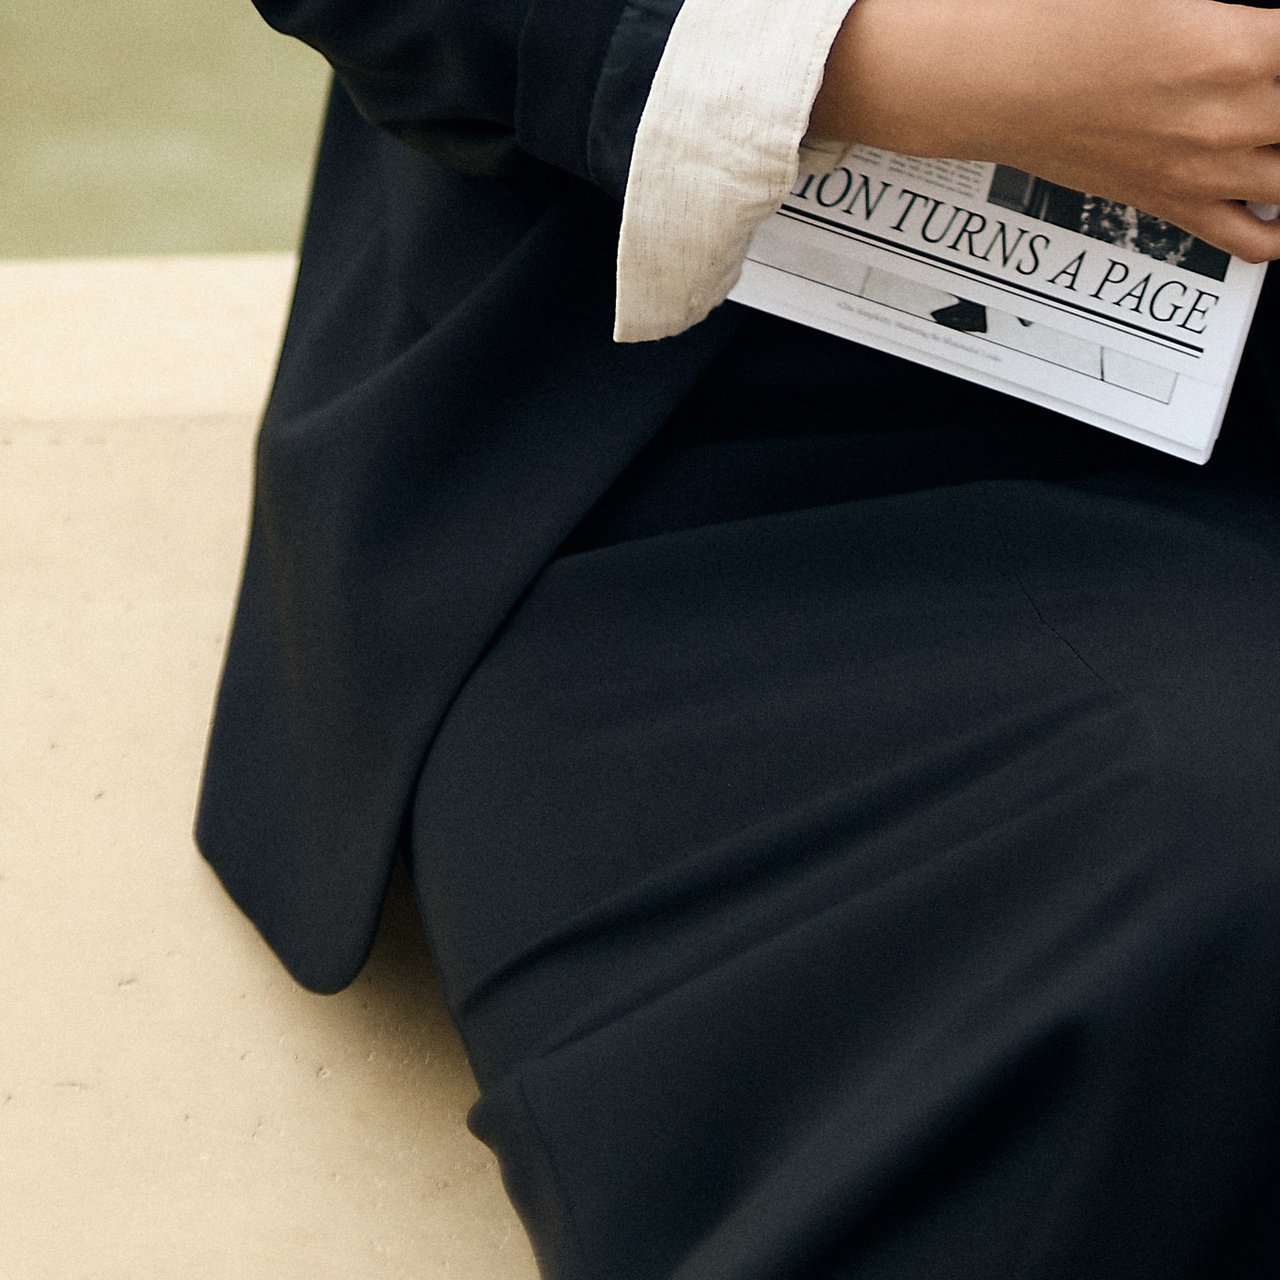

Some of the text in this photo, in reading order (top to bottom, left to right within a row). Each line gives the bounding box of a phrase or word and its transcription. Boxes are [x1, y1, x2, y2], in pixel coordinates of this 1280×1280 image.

[790, 167, 892, 221] ION
[890, 189, 1051, 275] TURNS
[1046, 250, 1087, 292] A
[1089, 258, 1220, 335] PAGE
